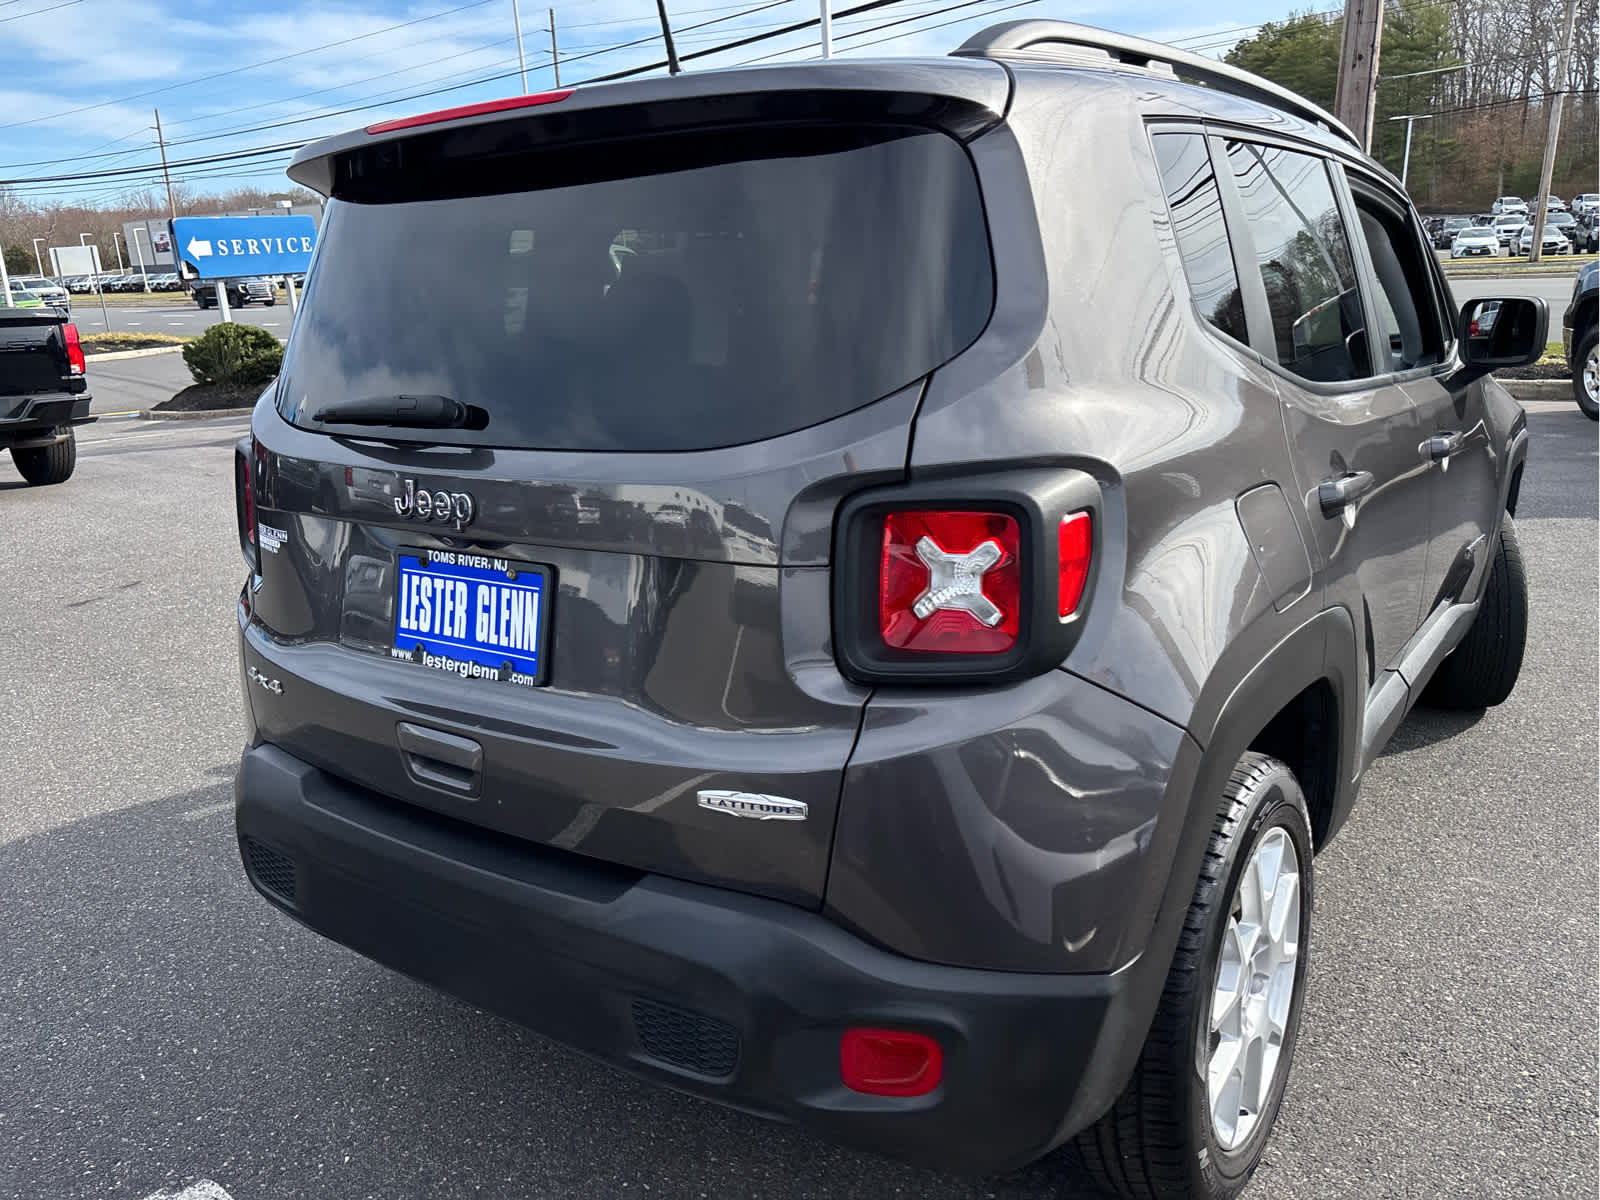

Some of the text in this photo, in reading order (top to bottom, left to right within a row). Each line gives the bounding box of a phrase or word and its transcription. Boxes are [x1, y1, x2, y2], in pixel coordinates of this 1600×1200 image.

[217, 236, 313, 256] SERVICE
[394, 479, 472, 531] Jeep
[427, 550, 509, 572] TOMS RIVER, NJ
[400, 573, 539, 652] LESTER GLENN
[422, 651, 499, 681] lesterglenn
[508, 672, 534, 686] .com
[706, 797, 798, 815] LATITUDE
